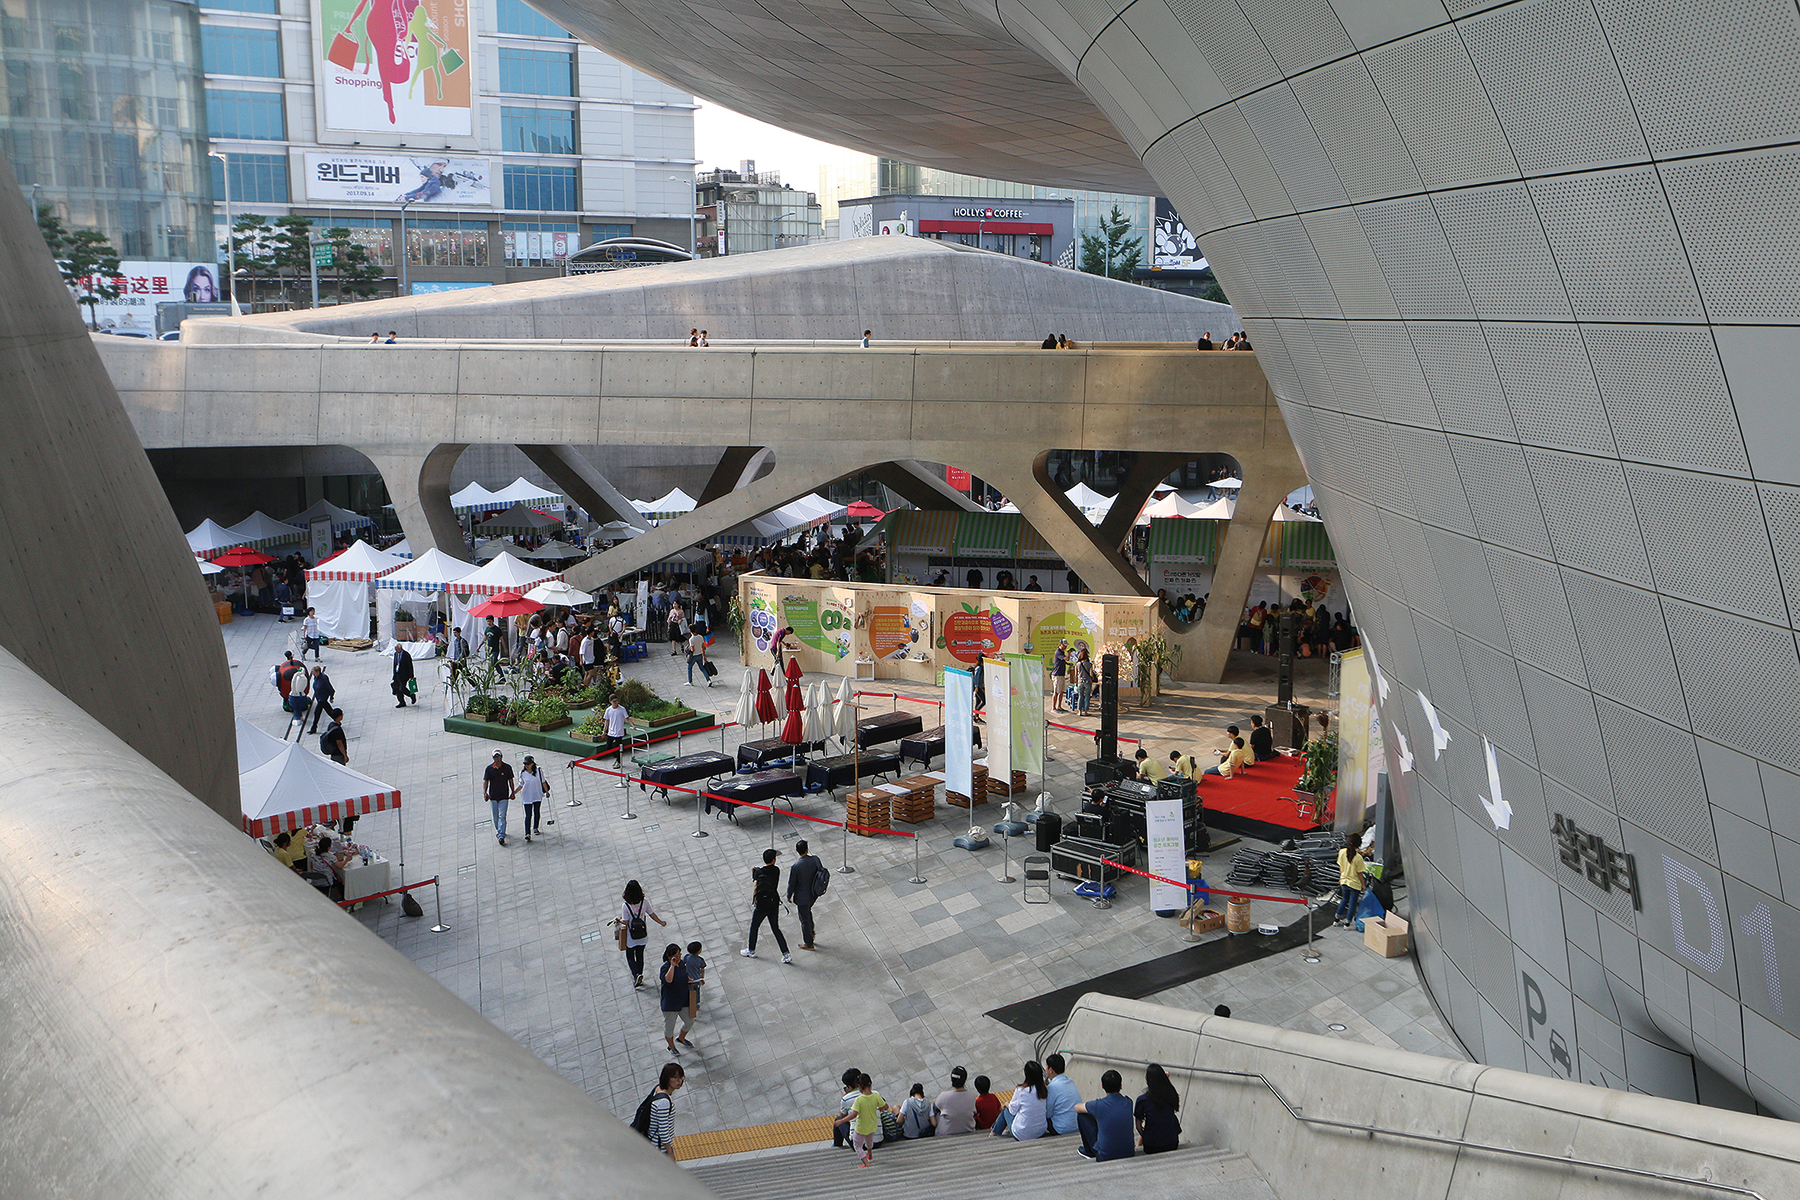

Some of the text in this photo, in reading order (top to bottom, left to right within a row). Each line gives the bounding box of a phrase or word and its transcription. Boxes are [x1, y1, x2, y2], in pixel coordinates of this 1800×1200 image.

[335, 76, 383, 90] Shopping
[317, 162, 400, 184] 윈드리버
[954, 208, 1023, 219] HOLLYS COFFEE
[1551, 812, 1641, 912] 살림터
[1661, 853, 1785, 1018] D1
[1522, 970, 1547, 1042] P
